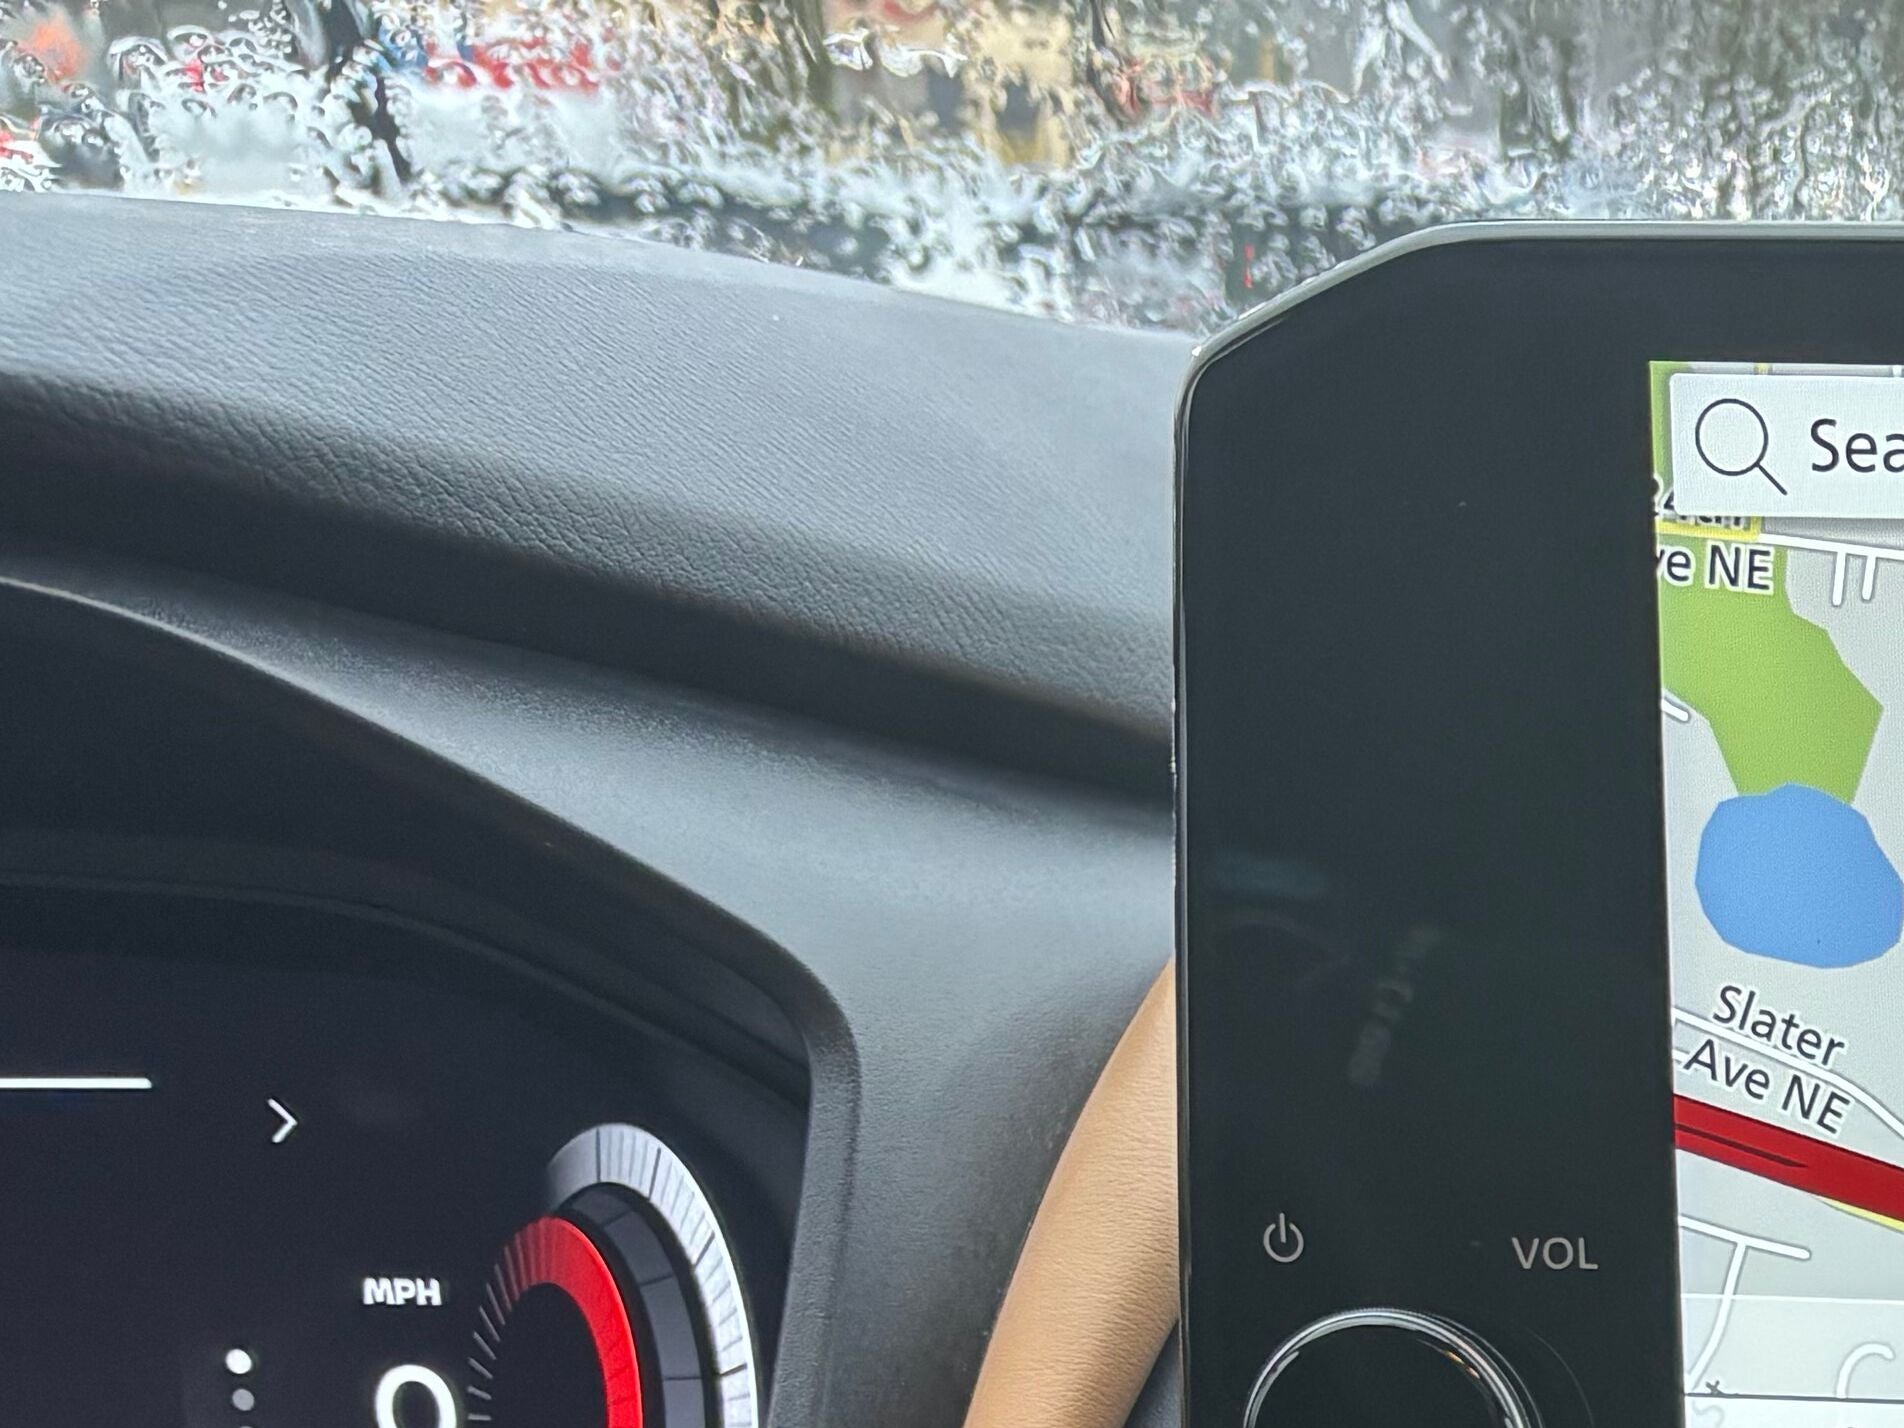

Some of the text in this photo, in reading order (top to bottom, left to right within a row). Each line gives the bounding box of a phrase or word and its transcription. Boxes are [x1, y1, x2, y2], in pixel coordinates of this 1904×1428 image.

[1655, 543, 1771, 591] e NE
[1712, 984, 1846, 1066] Slater
[1683, 1038, 1851, 1135] Ave NE
[1511, 1236, 1599, 1271] VOL
[361, 1276, 443, 1309] MPH
